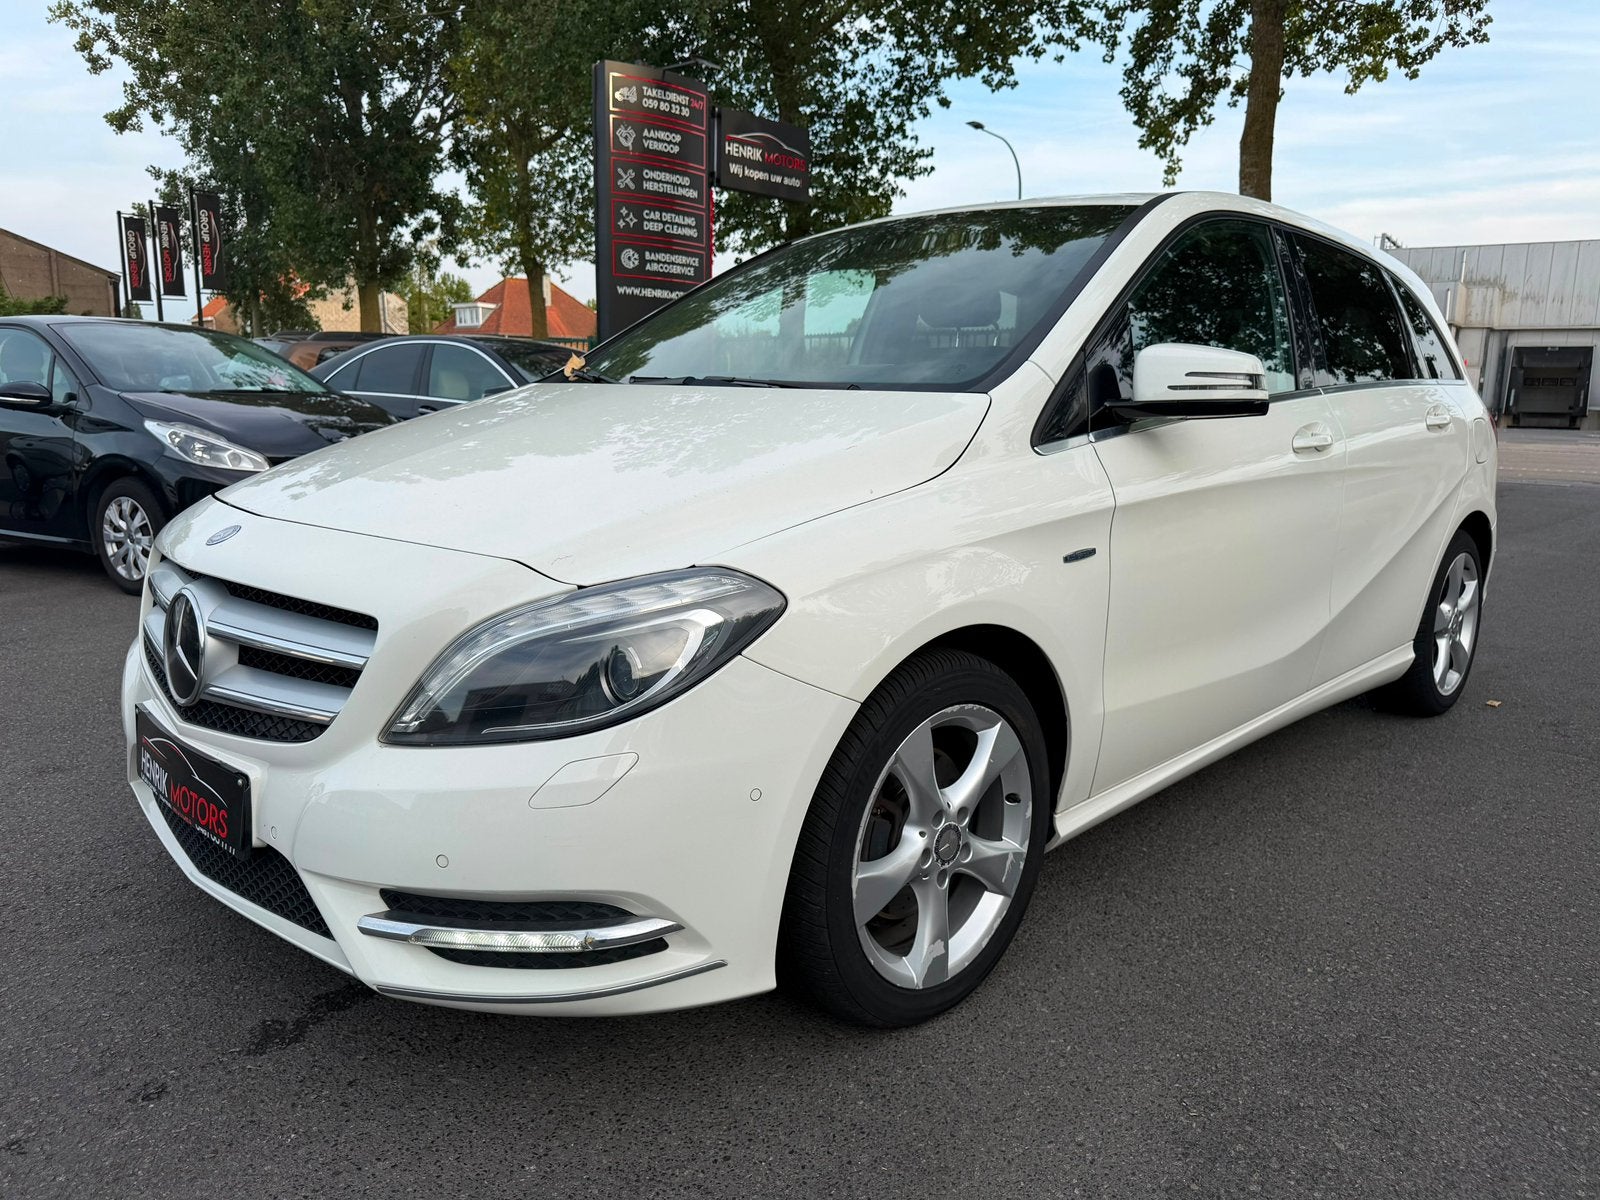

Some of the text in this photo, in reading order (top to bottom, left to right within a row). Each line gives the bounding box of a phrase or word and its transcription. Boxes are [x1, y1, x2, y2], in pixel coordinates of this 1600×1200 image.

[642, 86, 704, 110] TAKELDIENST 24/7
[642, 98, 690, 117] 059 80 32 30
[642, 128, 681, 143] AANKOOP
[642, 139, 680, 154] VERKOOP
[725, 141, 807, 172] HENRIK MOTORS
[643, 169, 690, 186] ONDERHOUD
[729, 162, 743, 178] Wij
[744, 165, 769, 181] kopen
[770, 174, 782, 183] uw
[643, 181, 698, 199] HERSTELLINGEN
[643, 210, 696, 227] CAR DETAILING
[160, 220, 170, 249] HENRIK
[643, 221, 698, 238] DEEP CLEANING
[127, 230, 137, 260] GROUP
[200, 209, 213, 276] GROUP HENRIK
[645, 251, 699, 267] BANDENSERVICE
[645, 262, 695, 276] AIRCOSERVICE
[141, 746, 228, 839] HENRIK MOTORS
